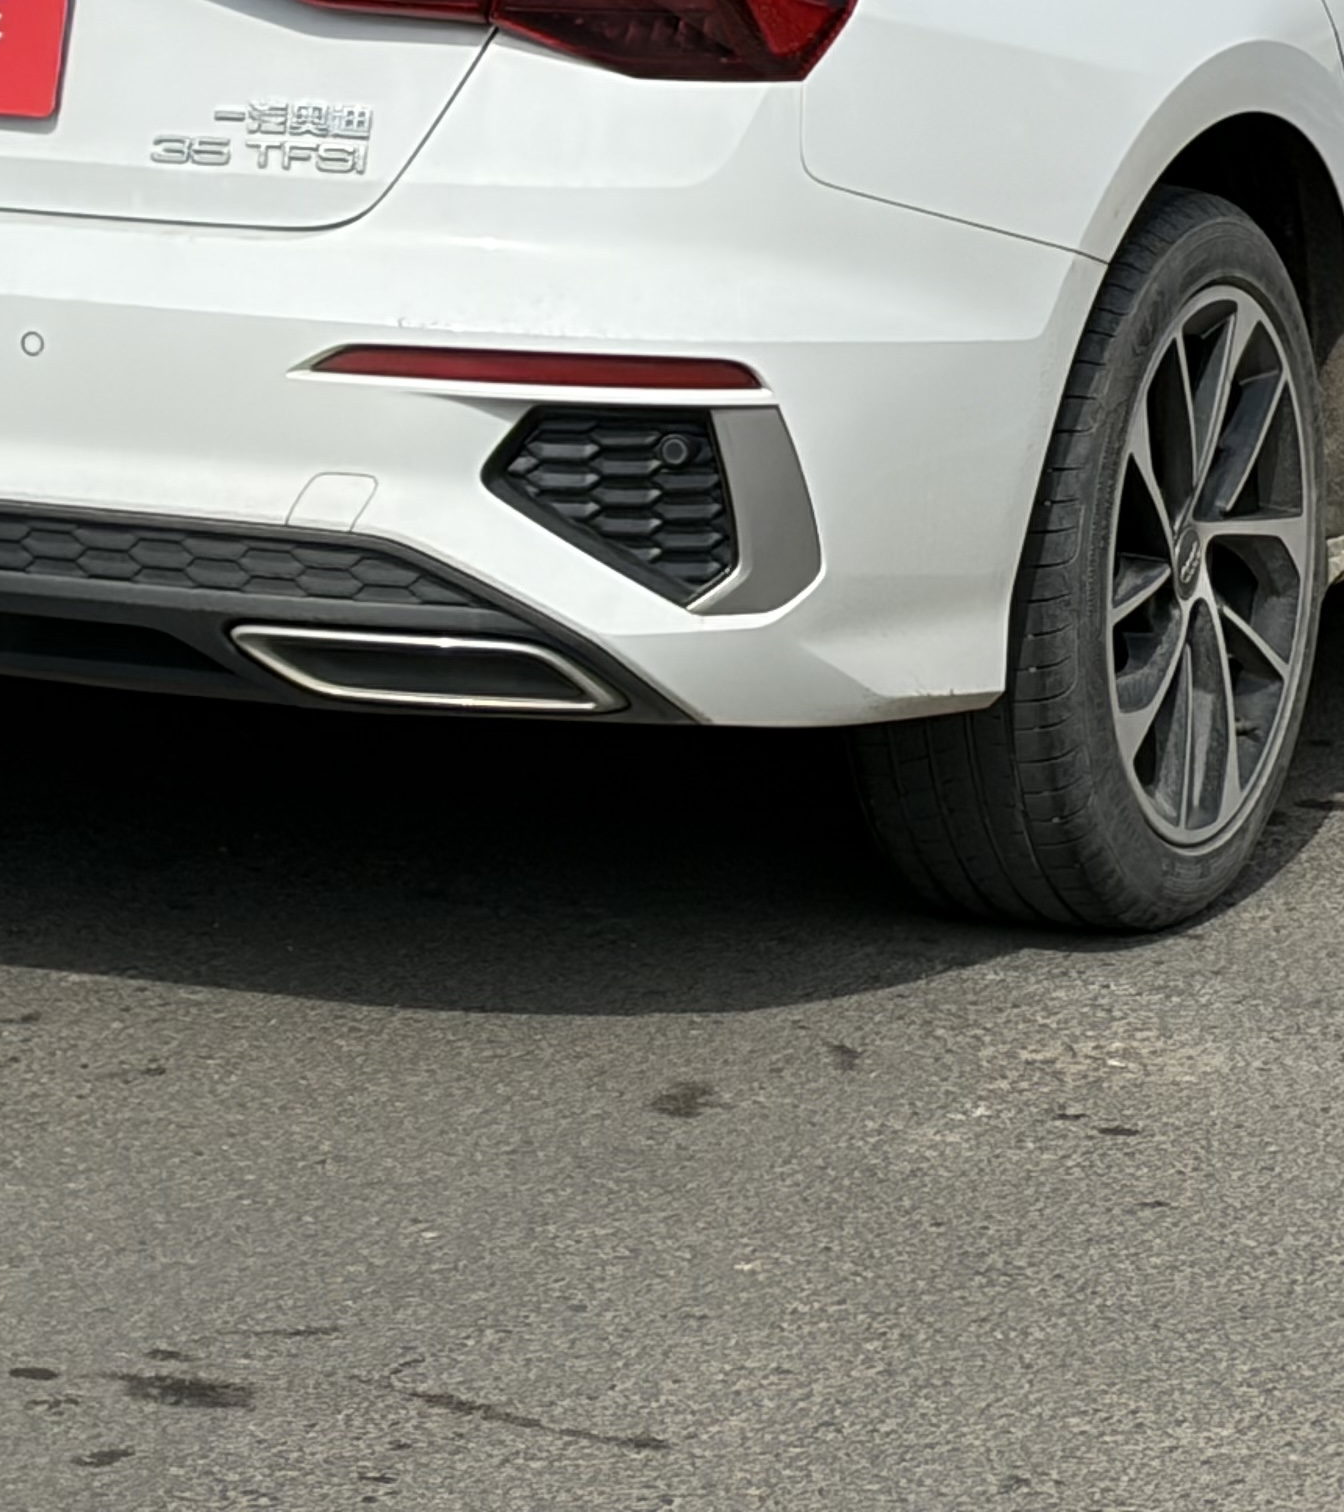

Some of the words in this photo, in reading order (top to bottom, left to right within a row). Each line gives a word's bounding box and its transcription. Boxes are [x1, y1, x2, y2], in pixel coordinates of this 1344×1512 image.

[212, 98, 373, 140] 一汽奥迪
[150, 135, 231, 167] 35
[244, 139, 368, 176] TFSI
